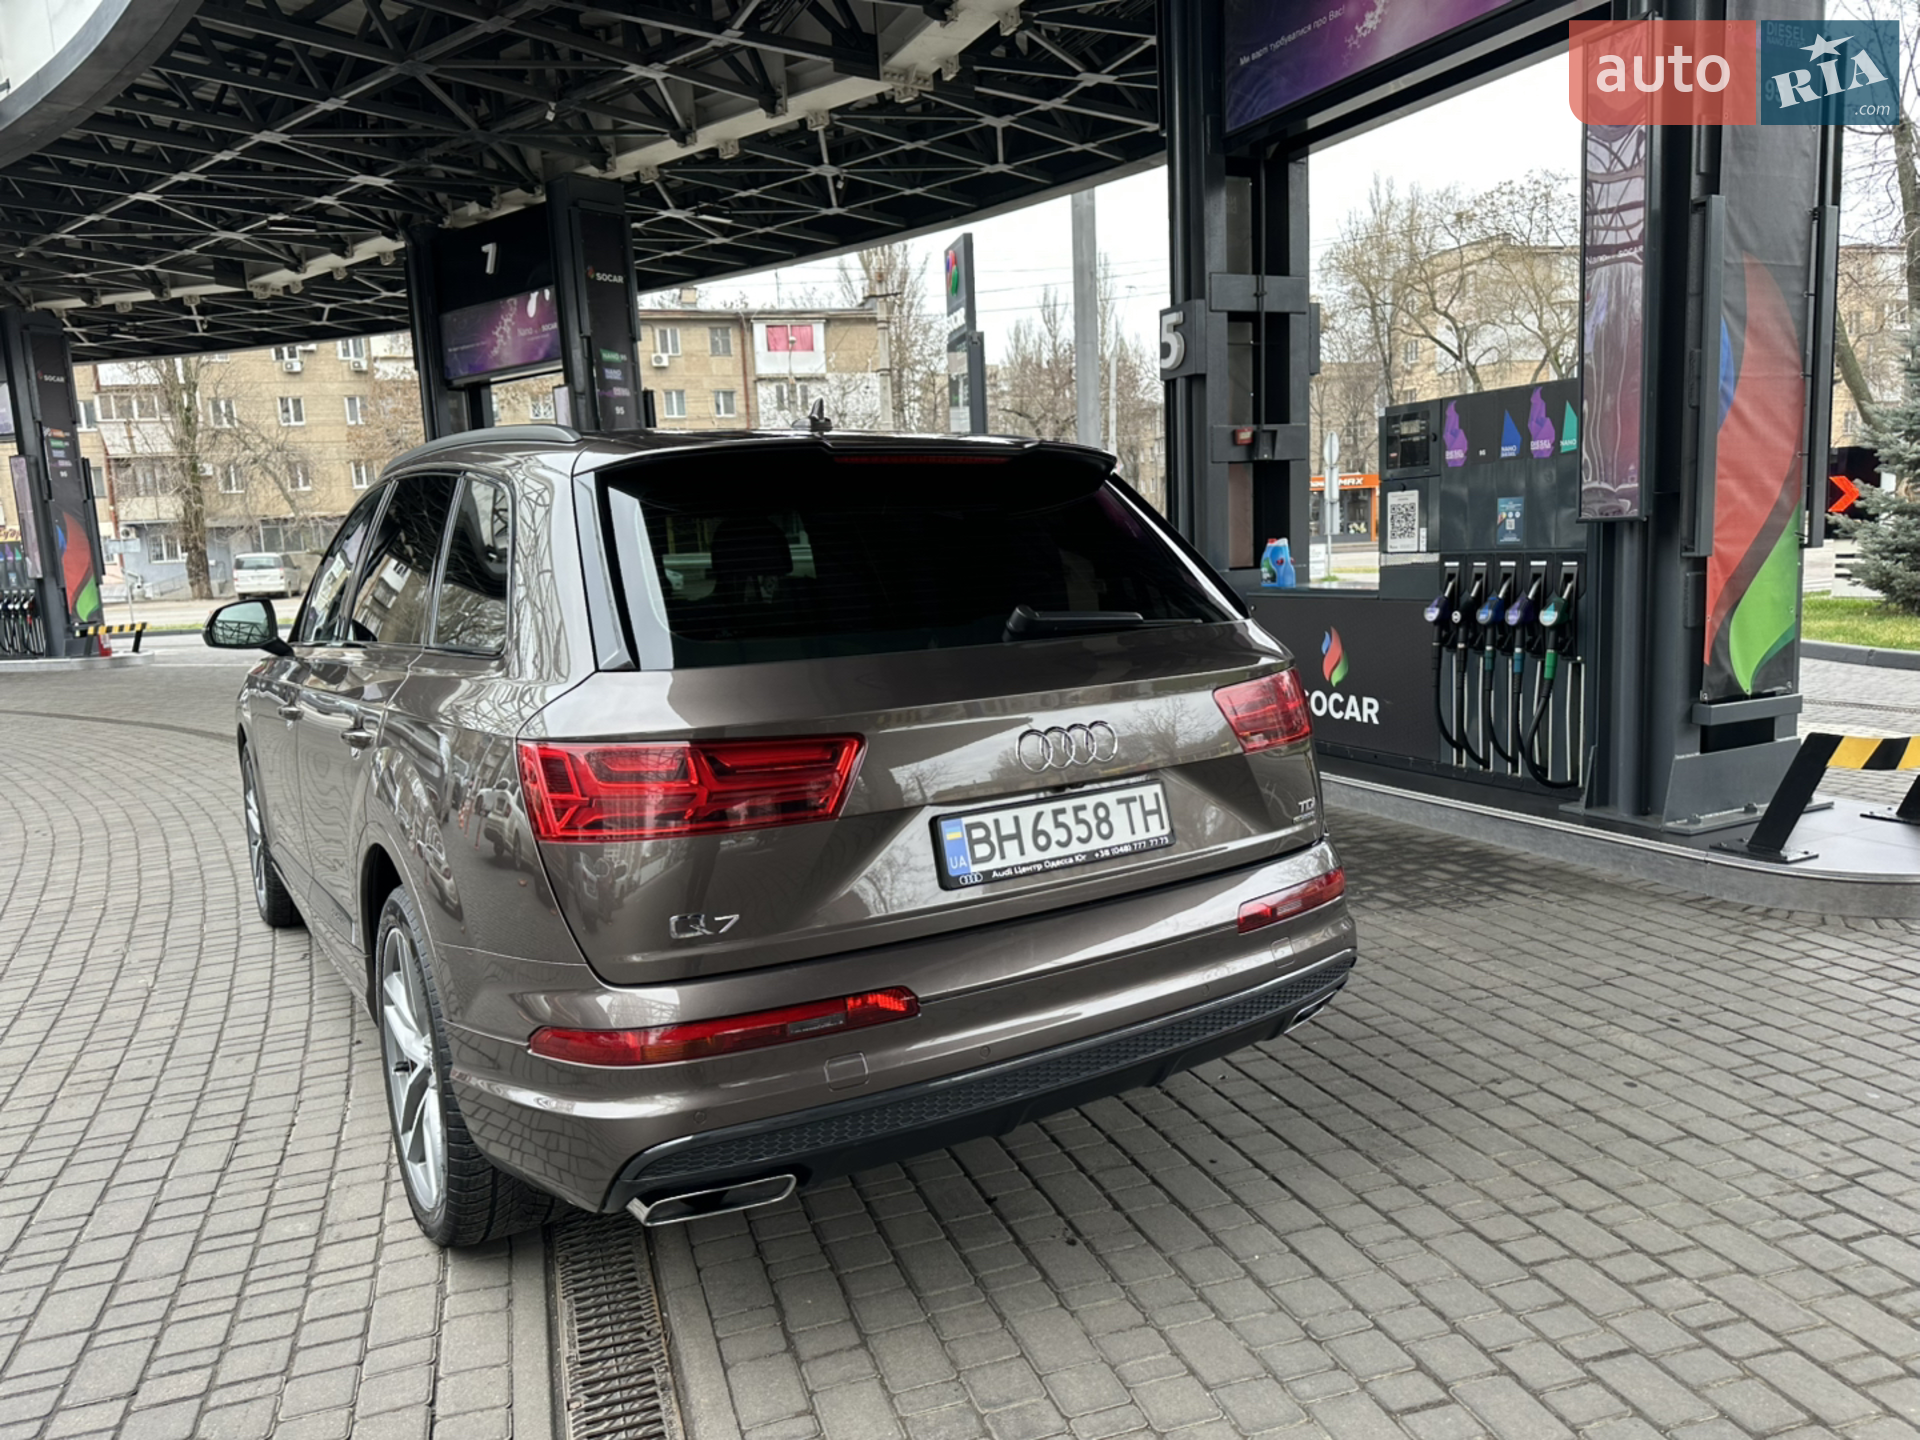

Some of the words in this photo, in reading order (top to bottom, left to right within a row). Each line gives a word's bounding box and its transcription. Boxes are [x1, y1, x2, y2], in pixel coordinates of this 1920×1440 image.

[1313, 17, 1328, 30] про
[1329, 5, 1345, 21] Вас!
[1766, 21, 1806, 41] DIESEL
[481, 242, 497, 275] 1
[596, 272, 624, 284] SOCAR
[1160, 311, 1185, 371] 5
[43, 374, 65, 383] SOCAR
[615, 406, 625, 415] 95
[1304, 689, 1380, 725] OCAR
[965, 815, 1026, 865] BH
[1031, 801, 1114, 852] 6558
[1116, 792, 1166, 836] TH
[950, 855, 968, 870] UA
[992, 864, 1014, 879] Audi
[1132, 840, 1147, 851] 777
[669, 913, 740, 939] Q7
